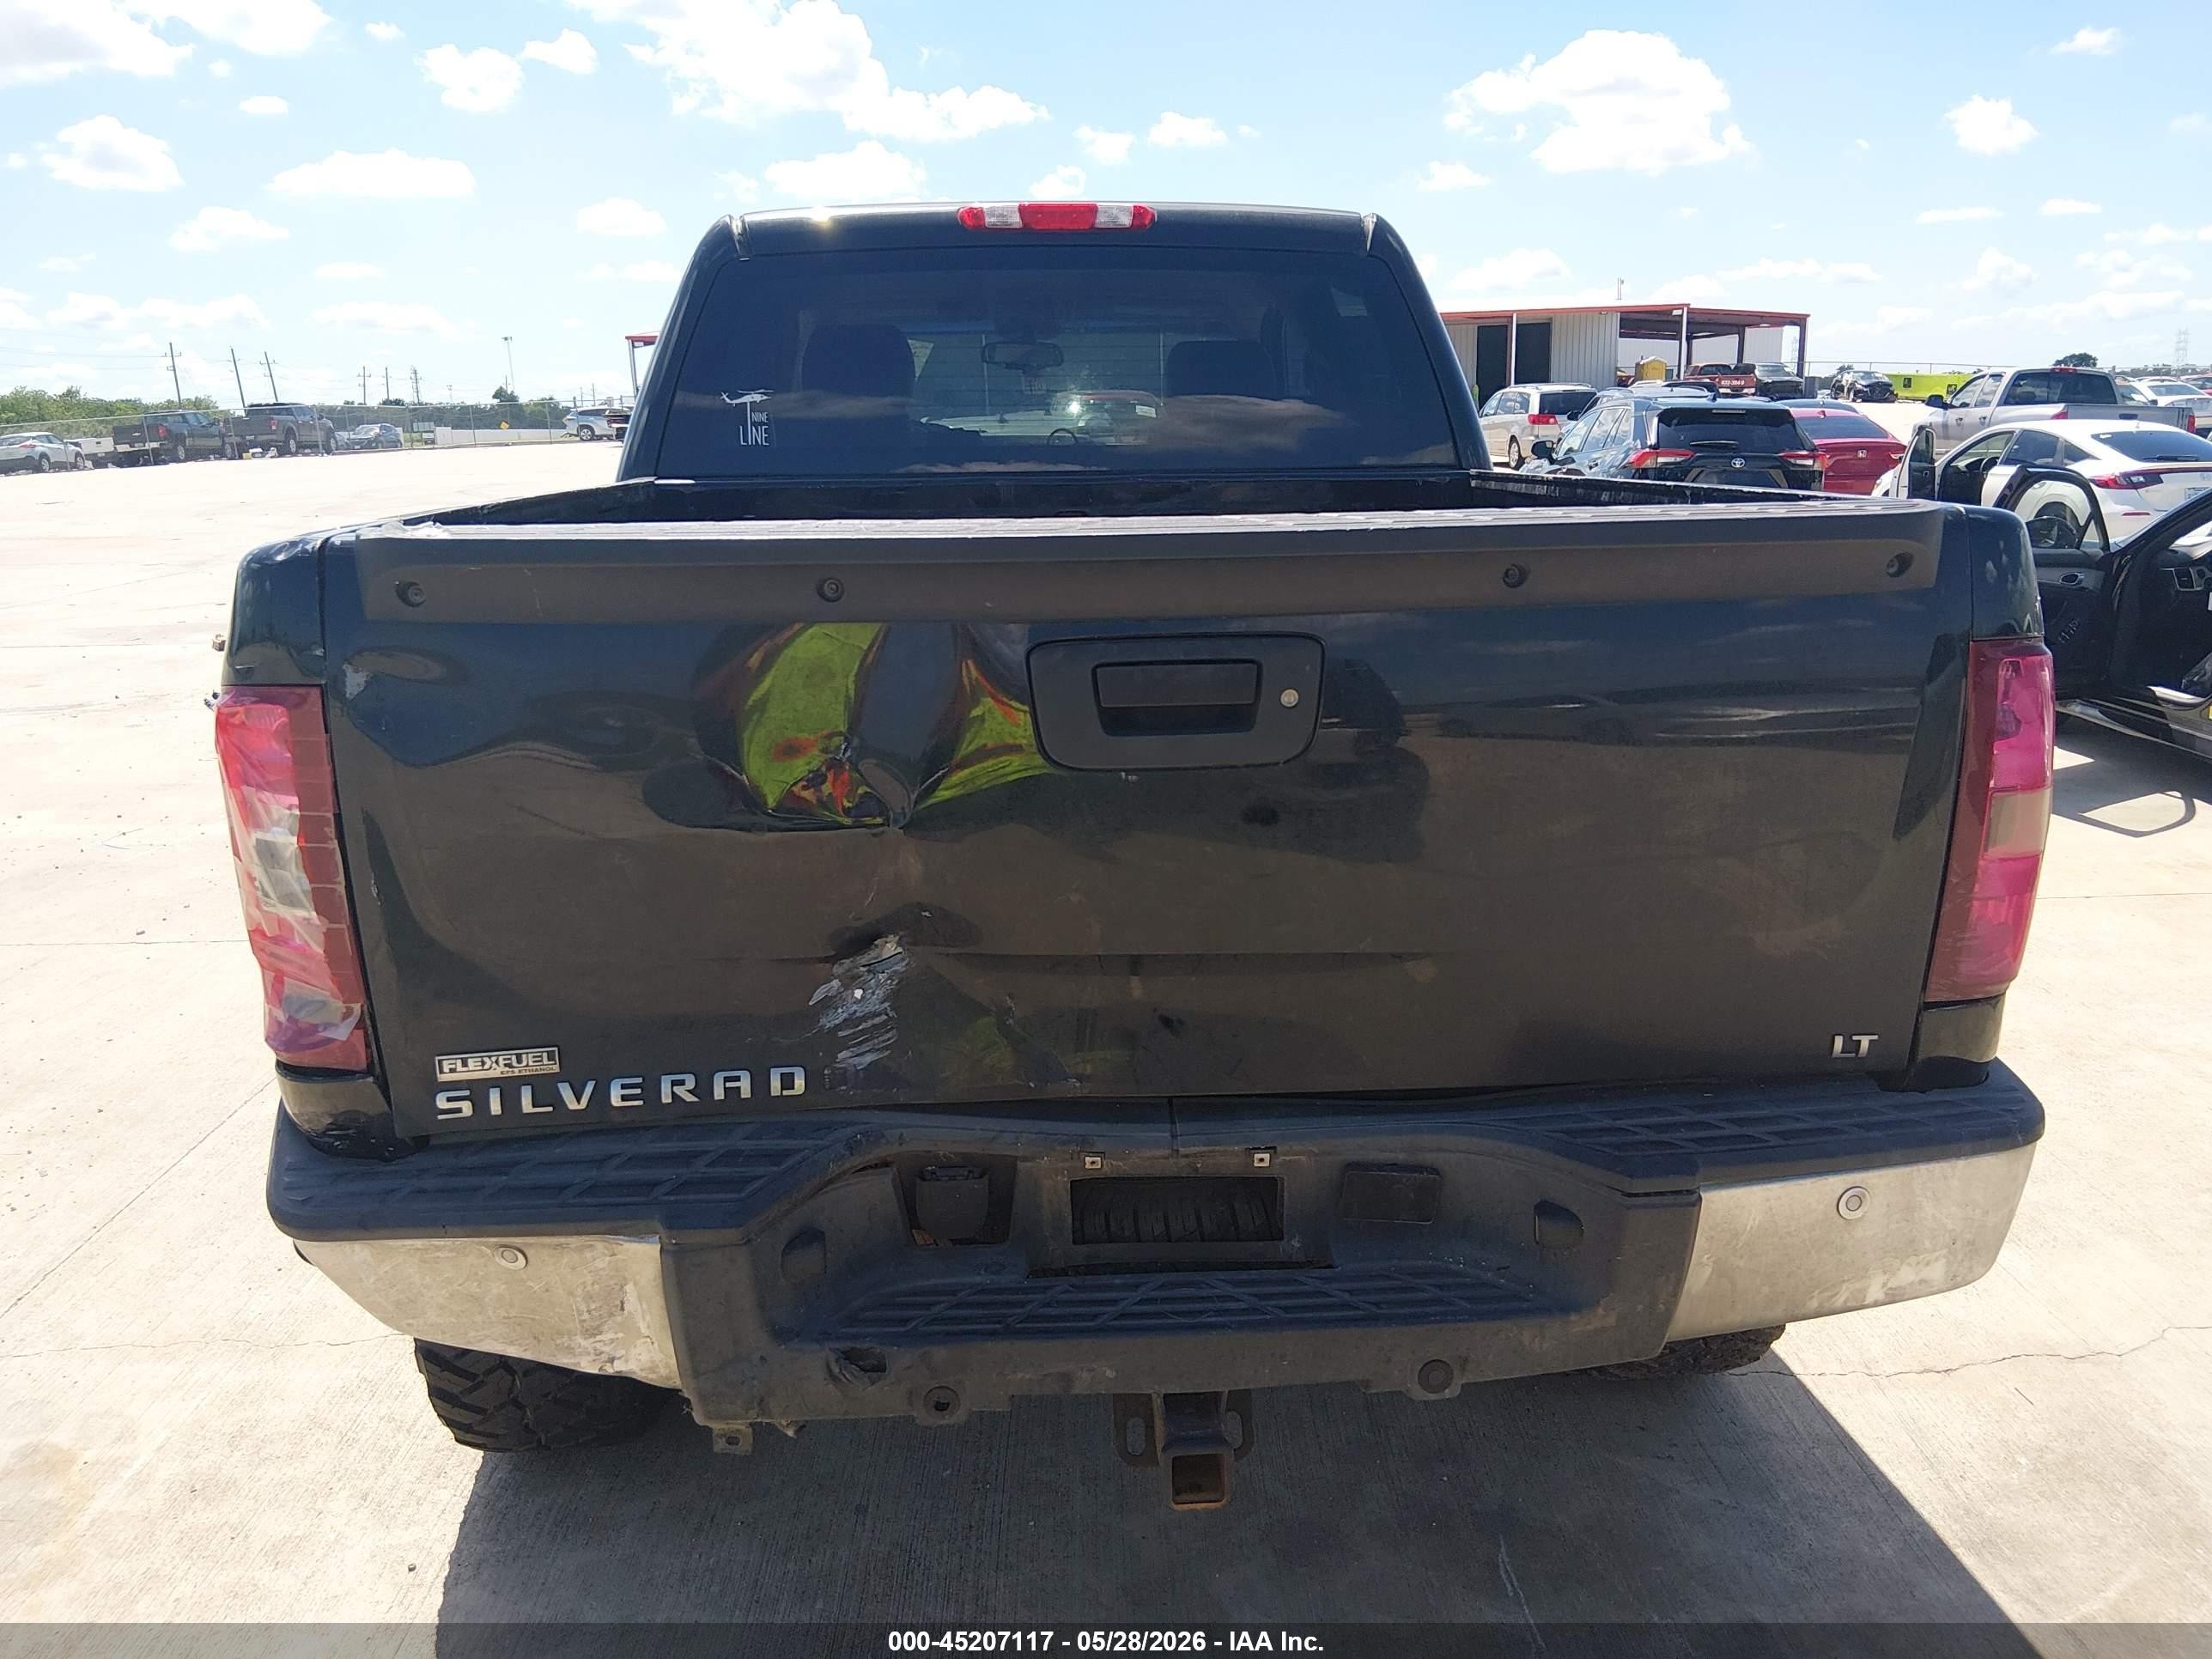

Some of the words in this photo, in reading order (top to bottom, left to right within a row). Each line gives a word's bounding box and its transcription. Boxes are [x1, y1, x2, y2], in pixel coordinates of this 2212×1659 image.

[751, 411, 769, 422] NINE
[739, 425, 769, 445] LINE
[1831, 1035, 1879, 1058] LT
[441, 1051, 556, 1073] FLEXFUEL
[436, 1066, 805, 1120] SILVERAD
